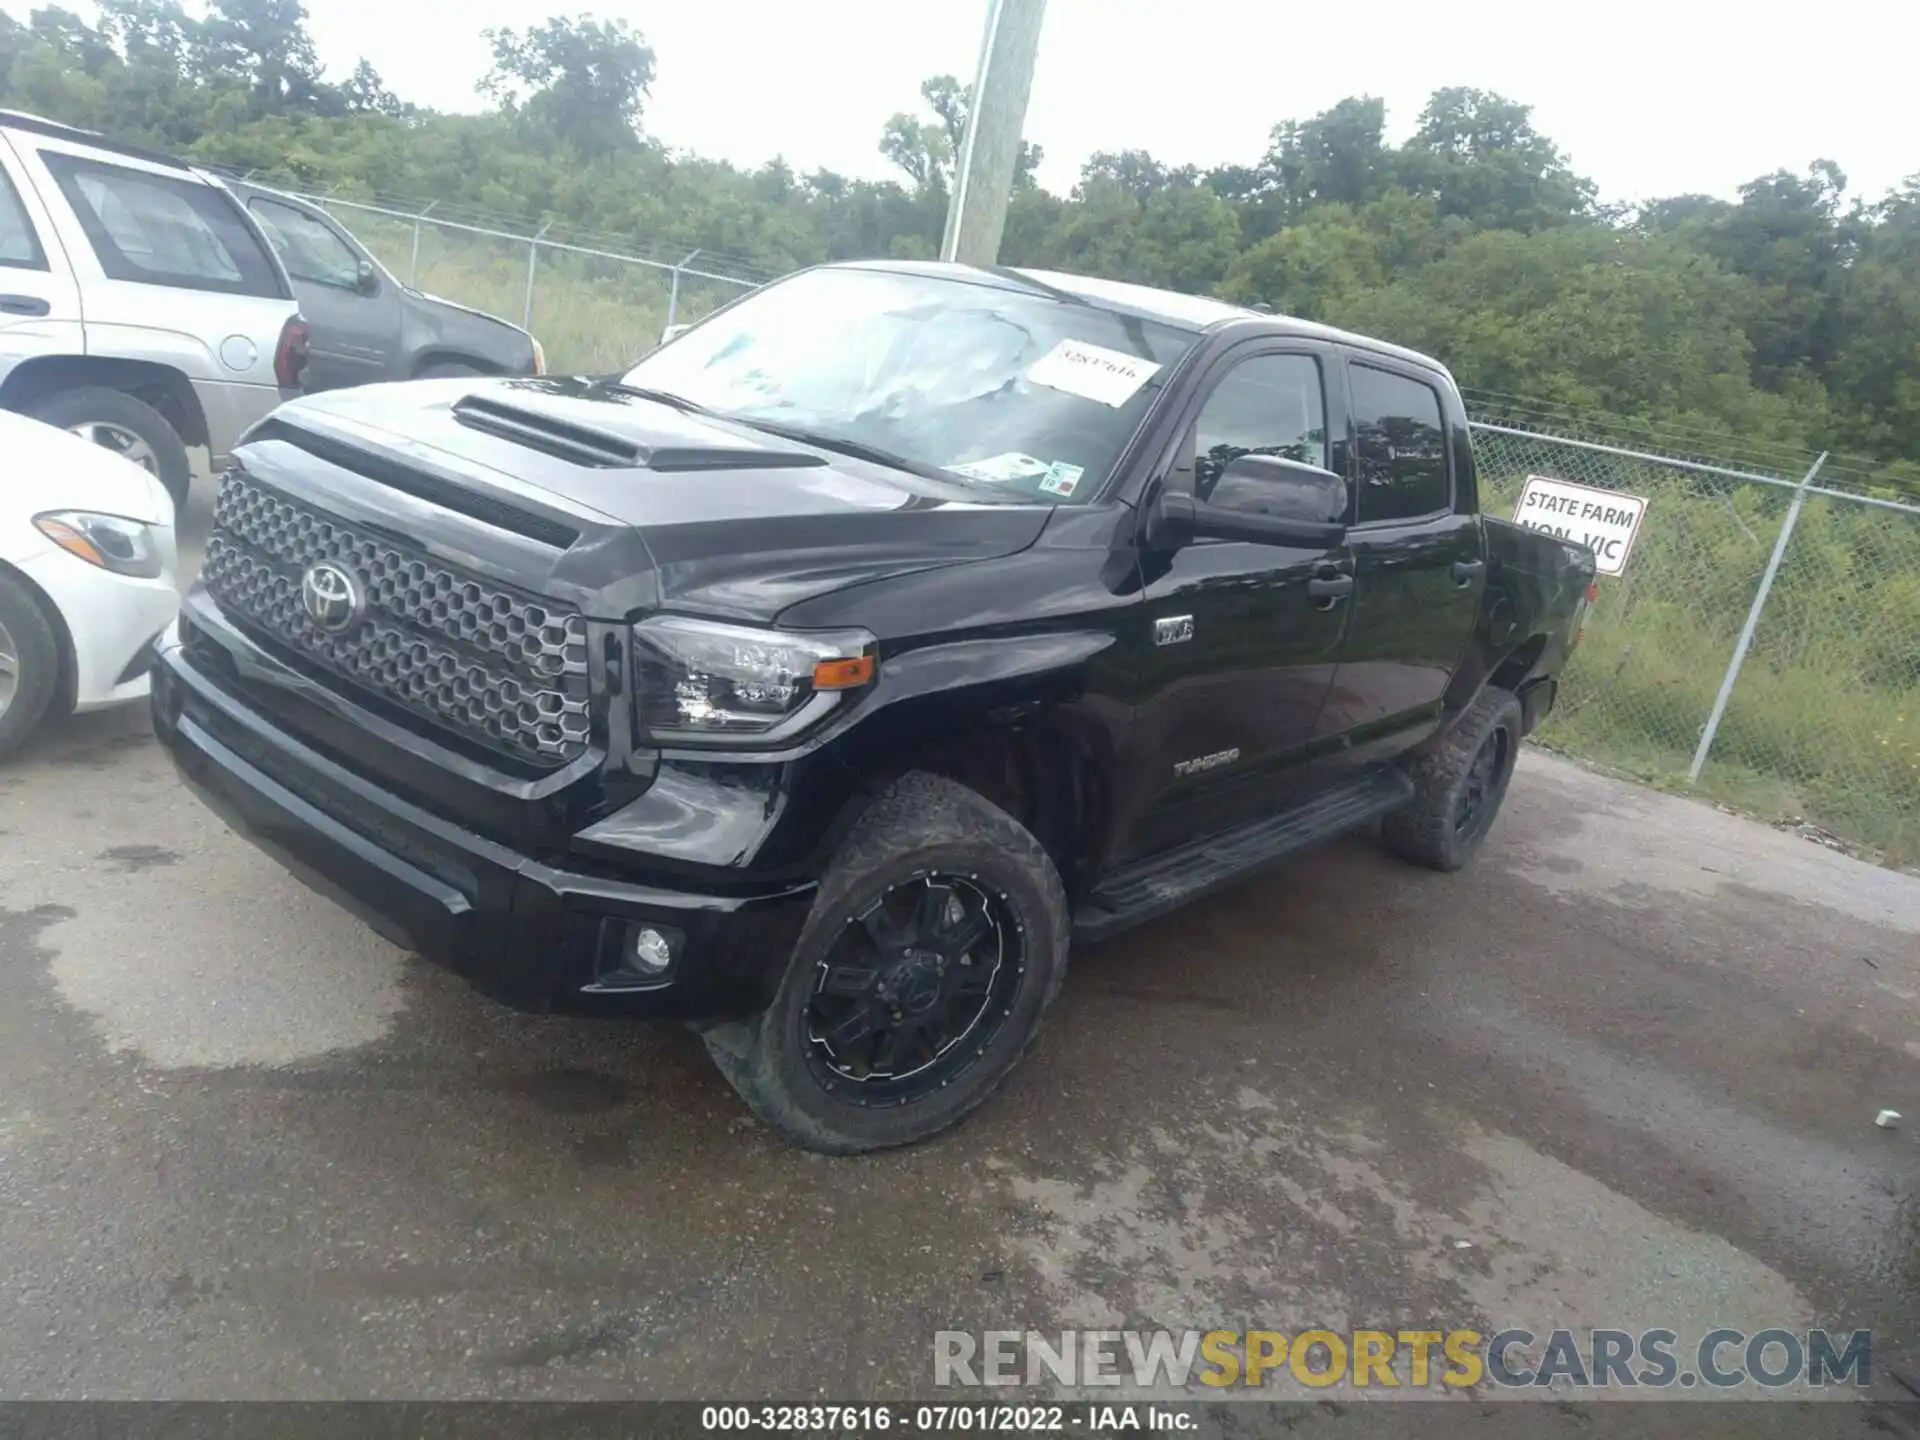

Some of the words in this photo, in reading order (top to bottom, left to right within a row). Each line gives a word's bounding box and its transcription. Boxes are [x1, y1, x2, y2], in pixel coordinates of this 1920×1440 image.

[1526, 491, 1580, 516] STATE
[1580, 501, 1635, 529] FARM
[1583, 532, 1624, 560] VIC
